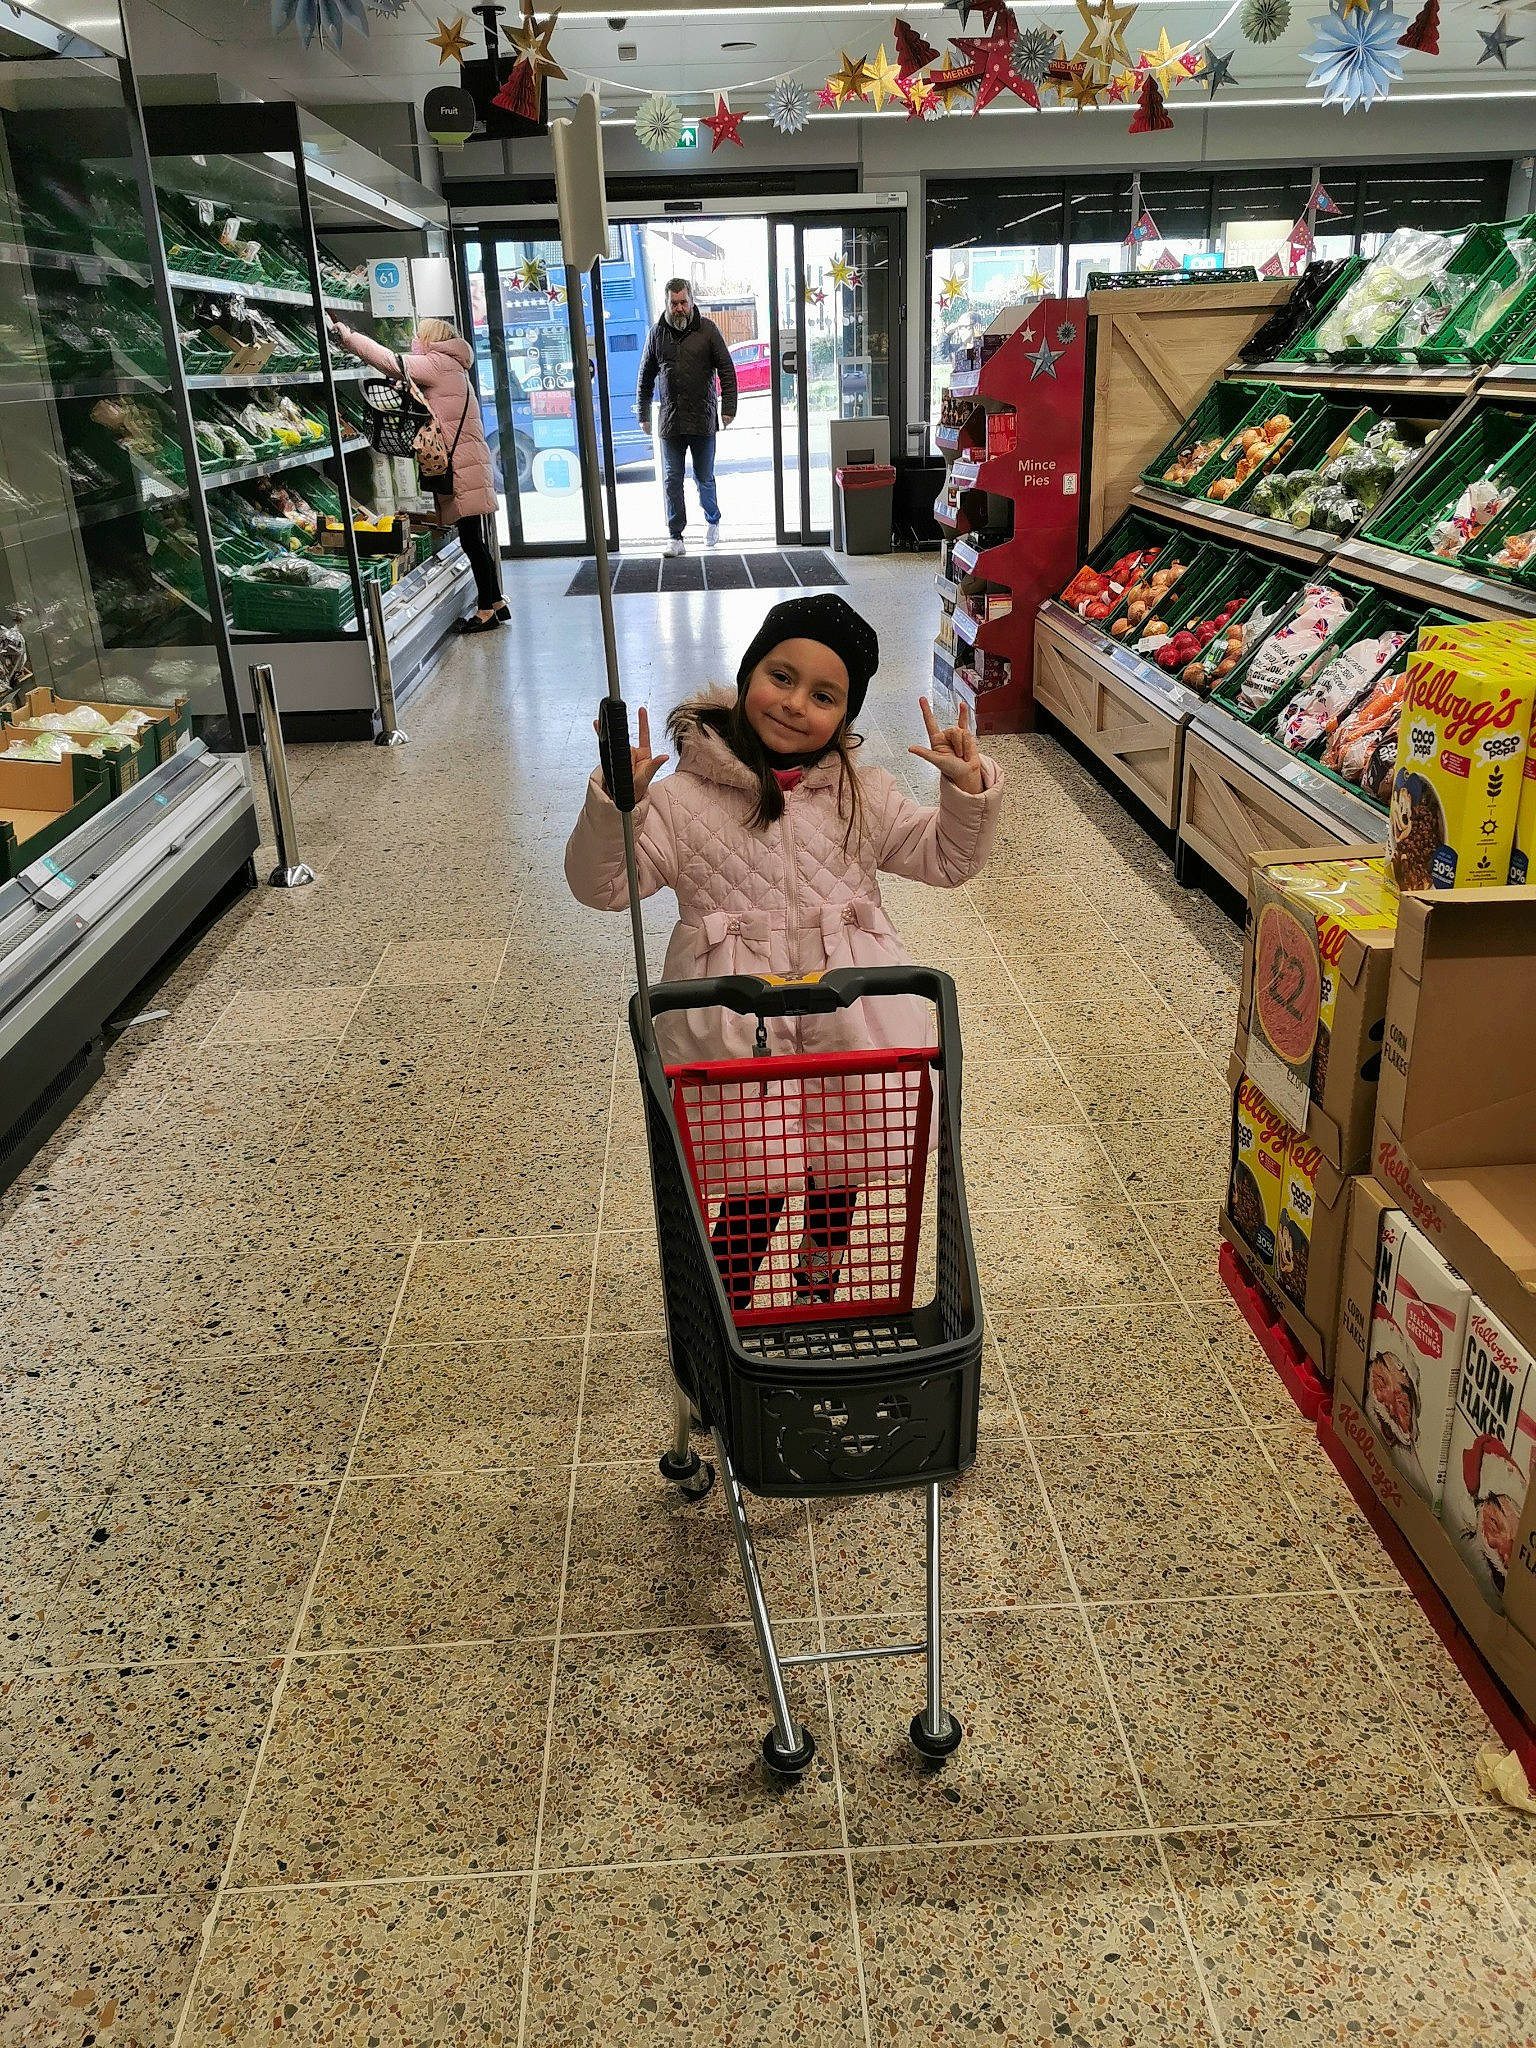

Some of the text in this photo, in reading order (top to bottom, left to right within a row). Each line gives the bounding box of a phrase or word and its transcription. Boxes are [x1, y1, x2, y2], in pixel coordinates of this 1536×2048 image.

[942, 65, 975, 80] MERRY
[440, 106, 459, 115] Fruit
[380, 272, 394, 285] 61
[1018, 459, 1056, 472] Mince
[1024, 474, 1050, 487] Pies
[1403, 660, 1523, 746] Kellogg's
[1432, 859, 1455, 880] 30%
[1389, 1023, 1408, 1053] CORN
[1384, 1042, 1409, 1077] FLAKES
[1378, 1142, 1443, 1234] Kellogg's
[1256, 1233, 1274, 1255] 30%
[1347, 1297, 1365, 1330] CORN
[1408, 1310, 1439, 1342] SEASON'S
[1343, 1312, 1366, 1353] FLAKES
[1407, 1321, 1441, 1354] GREETINGS
[1471, 1314, 1519, 1375] Kellogg's
[1465, 1334, 1515, 1425] CORN
[1338, 1402, 1402, 1509] Kellogg's
